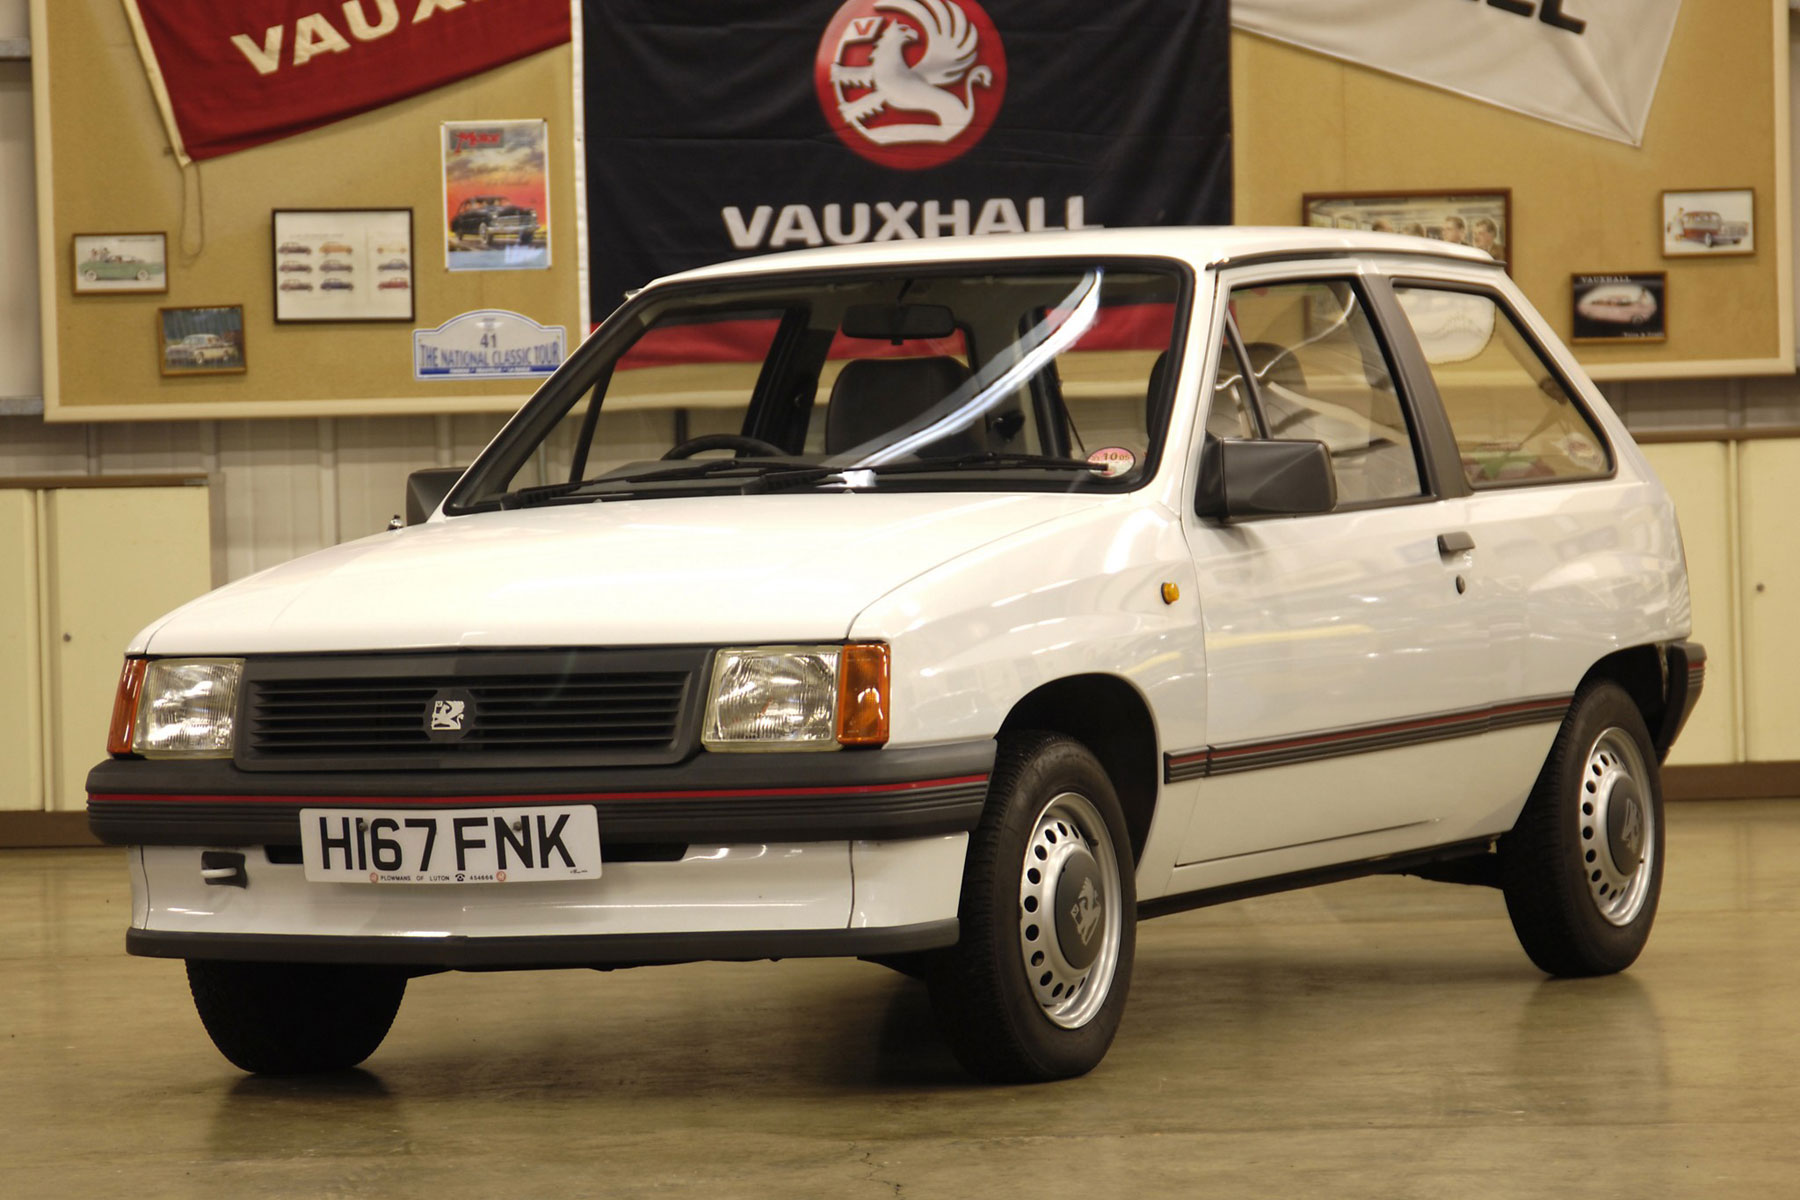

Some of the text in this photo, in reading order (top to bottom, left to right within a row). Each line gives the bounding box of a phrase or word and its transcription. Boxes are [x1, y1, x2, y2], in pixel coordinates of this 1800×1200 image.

[722, 195, 1104, 248] VAUXHALL
[420, 340, 561, 367] THE NATIONAL CLASSIC TOUR
[480, 334, 497, 348] 41
[319, 814, 577, 872] H167 FNK
